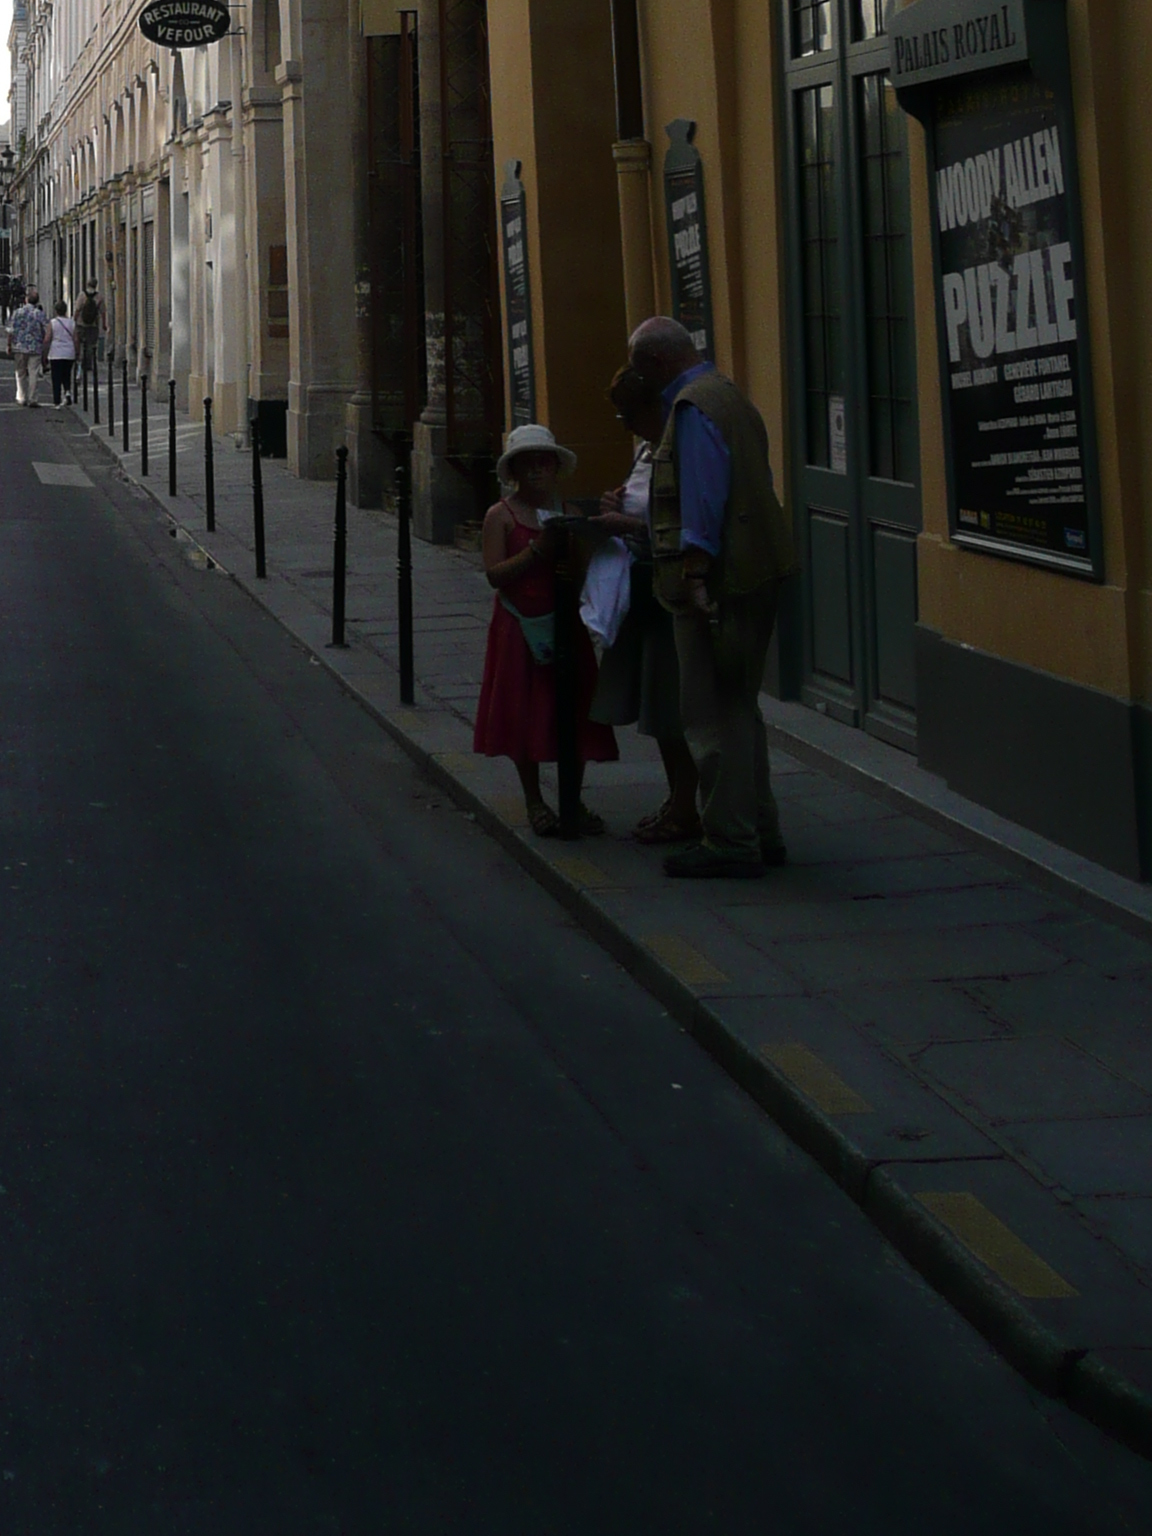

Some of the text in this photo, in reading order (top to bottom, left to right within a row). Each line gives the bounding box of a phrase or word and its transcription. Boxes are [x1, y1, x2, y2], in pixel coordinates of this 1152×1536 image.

[144, 2, 225, 25] RESTAURANT
[157, 24, 215, 42] VEFOUR
[894, 5, 1016, 75] PALAIS ROYAL
[936, 125, 1065, 232] WOODY ALLEN
[942, 241, 1078, 362] PUZZLE
